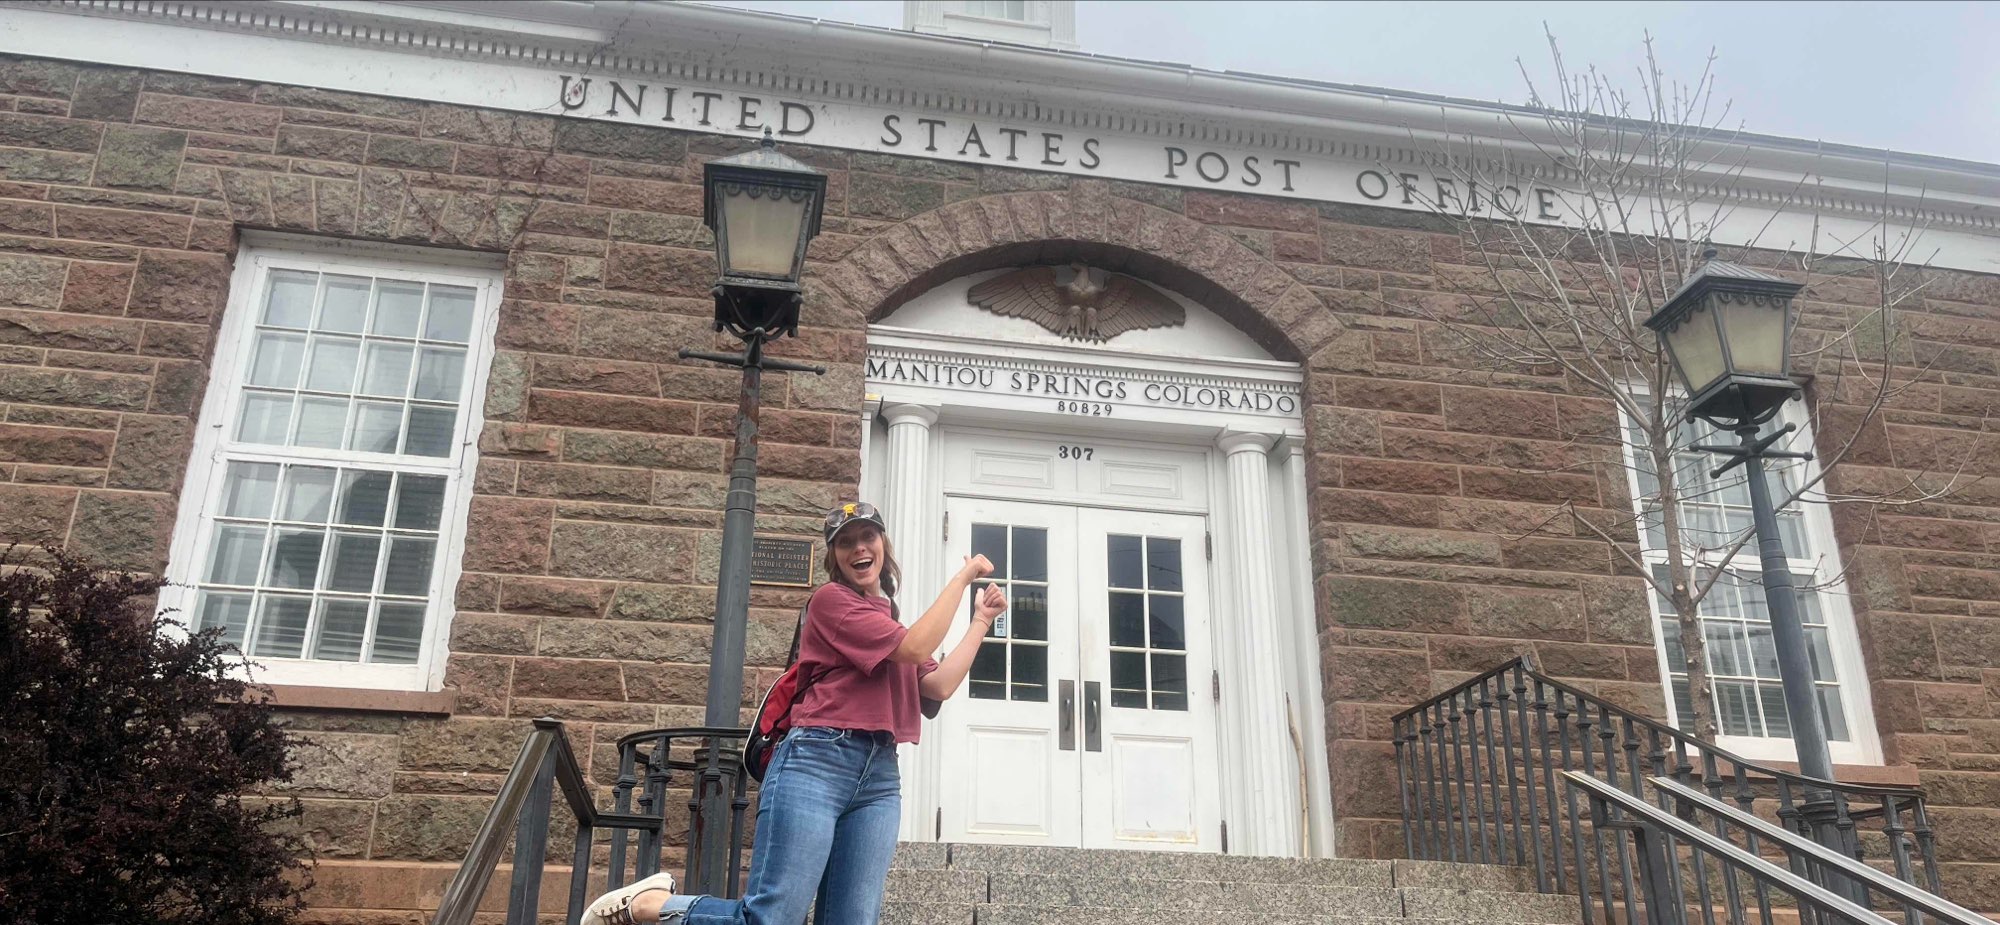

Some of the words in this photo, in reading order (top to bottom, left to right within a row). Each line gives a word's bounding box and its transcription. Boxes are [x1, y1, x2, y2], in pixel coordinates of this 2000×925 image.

[559, 75, 815, 136] UNITED
[881, 114, 1101, 169] STATES
[1164, 146, 1301, 192] POST
[1356, 169, 1562, 220] OFFICE
[866, 358, 994, 388] MANITOU
[1010, 372, 1127, 399] SPRINGS
[1144, 383, 1295, 413] COLORADO
[1057, 400, 1113, 416] 80829
[1058, 445, 1094, 461] 307
[752, 560, 782, 568] HISTORIC
[784, 562, 809, 570] PLACES
[778, 553, 809, 561] REGISTER
